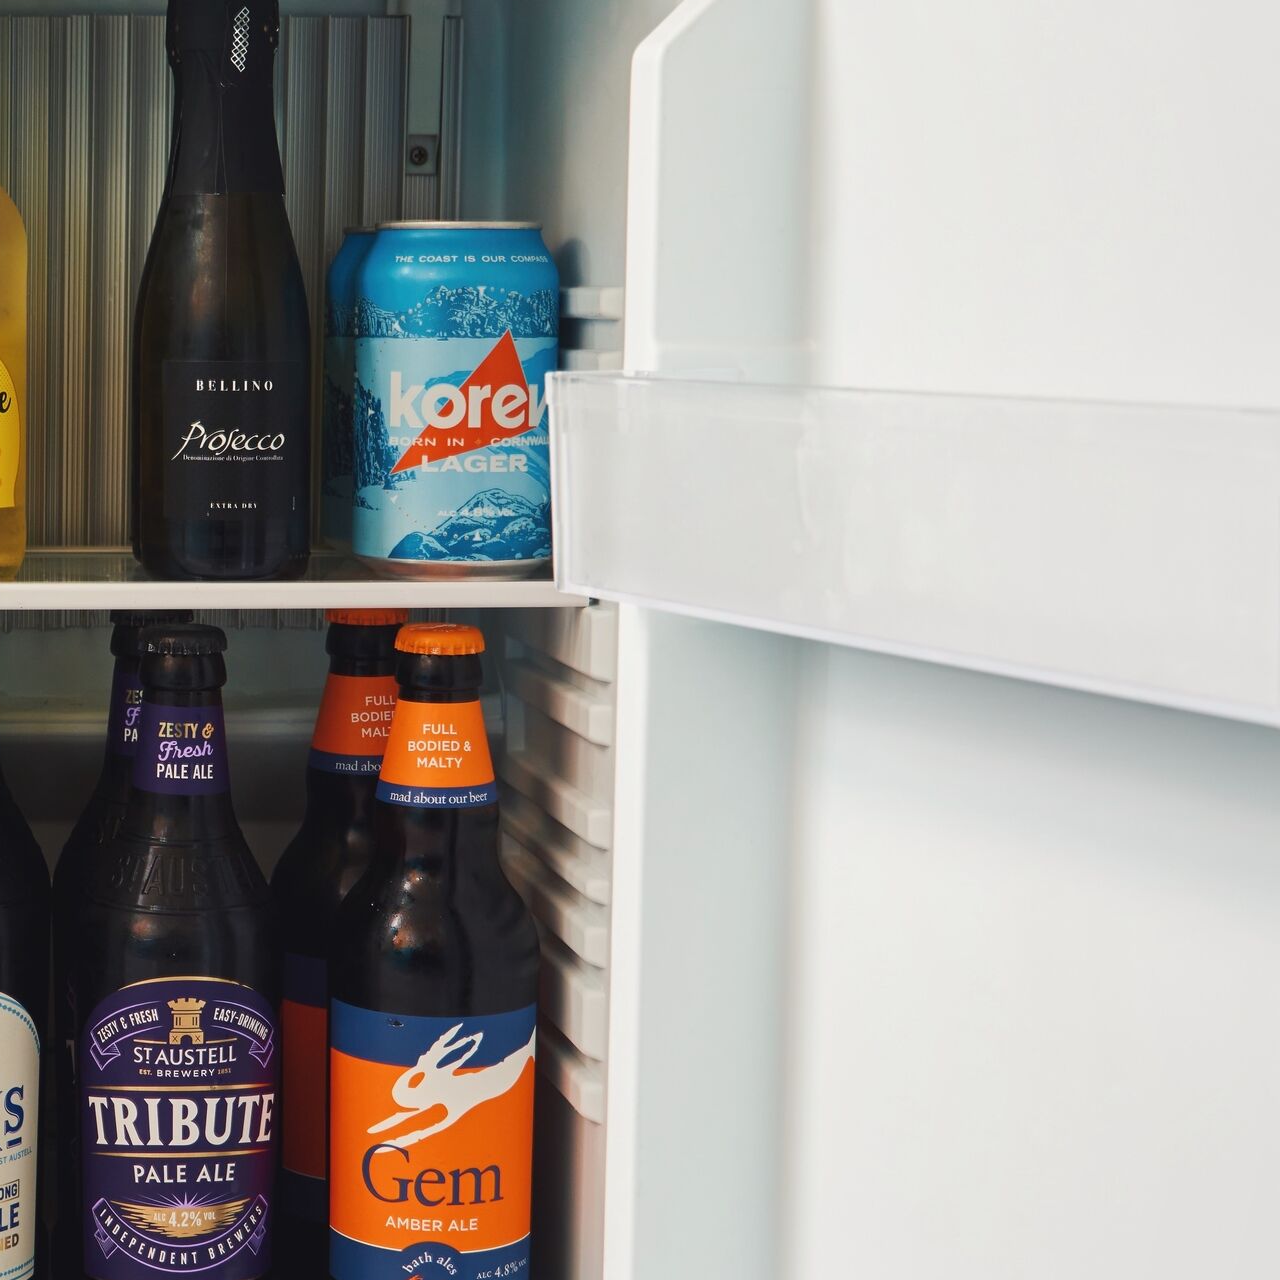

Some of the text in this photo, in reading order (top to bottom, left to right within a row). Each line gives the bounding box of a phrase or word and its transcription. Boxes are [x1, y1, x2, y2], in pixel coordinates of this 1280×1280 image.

[395, 255, 549, 264] THE COAST IS OUR COMPASS
[196, 379, 274, 392] BELLINO
[171, 420, 286, 461] Prosecco
[389, 437, 437, 447] BORN
[447, 437, 465, 447] IN
[421, 454, 528, 473] LAGER
[158, 721, 215, 740] ZESTY &
[422, 723, 458, 735] FULL
[157, 740, 215, 762] Fresh
[407, 740, 472, 752] BODIED &
[156, 763, 214, 780] PALE ALE
[335, 761, 359, 772] mad
[416, 757, 463, 769] MALTY
[390, 791, 488, 805] mad about our beer
[96, 1024, 120, 1044] ZESTY
[128, 1007, 160, 1028] FRESH
[213, 1006, 269, 1041] EASY-DRINKING
[154, 1045, 237, 1066] AUSTELL
[138, 1067, 232, 1079] EST. BREWERY 1851
[88, 1092, 275, 1147] TRIBUTE
[8, 1145, 33, 1162] AUSTELL
[132, 1162, 236, 1184] PALE ALE
[361, 1143, 504, 1207] Gem
[153, 1211, 216, 1228] ALC 4.2% VOL
[385, 1215, 479, 1233] AMBER ALE
[99, 1204, 263, 1266] INDEPENDENT BREWERS
[401, 1251, 458, 1277] bath ales
[476, 1270, 493, 1280] ALC
[494, 1260, 519, 1279] 4.8%
